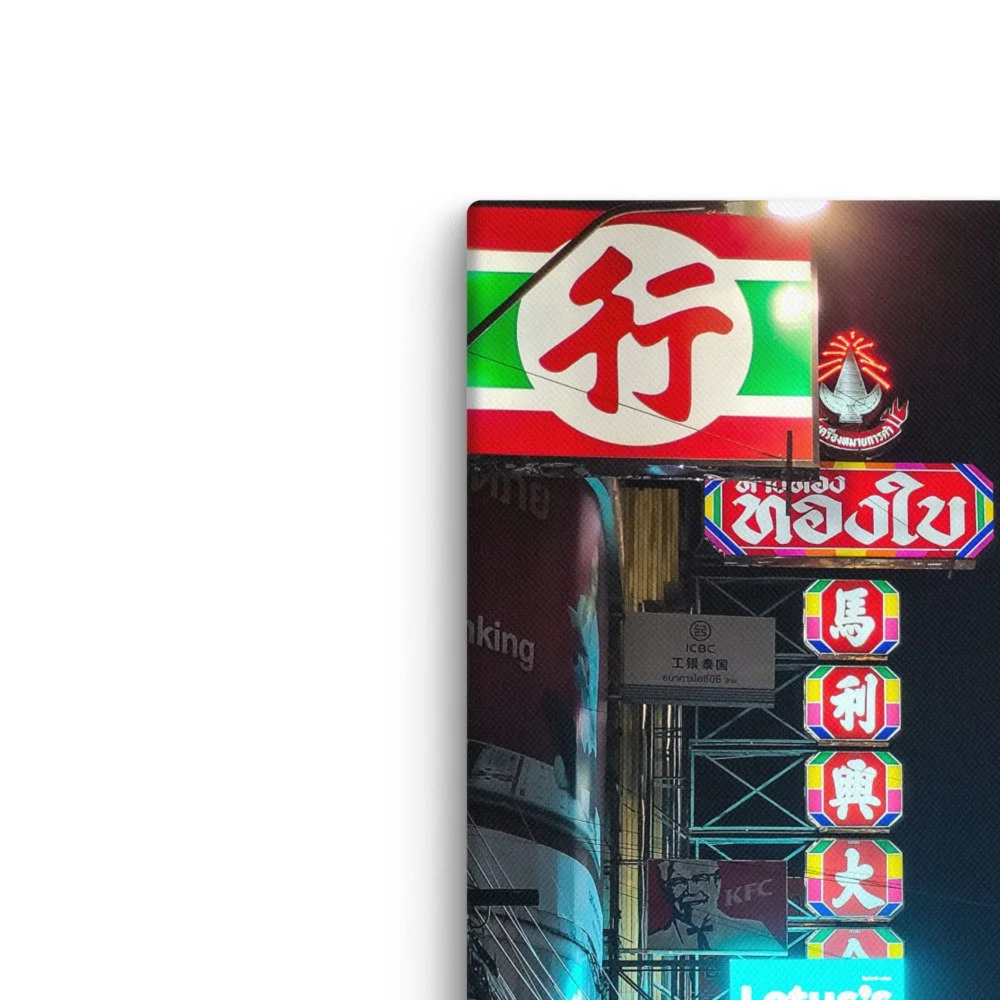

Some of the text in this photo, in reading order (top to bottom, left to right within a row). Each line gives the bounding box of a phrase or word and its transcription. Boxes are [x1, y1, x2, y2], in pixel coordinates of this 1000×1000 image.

[539, 245, 734, 421] 行
[735, 475, 845, 494] หางทอง
[731, 471, 968, 546] ทองใบ
[685, 643, 717, 654] ICBC
[672, 656, 729, 671] 工银泰国
[726, 878, 774, 907] KFC
